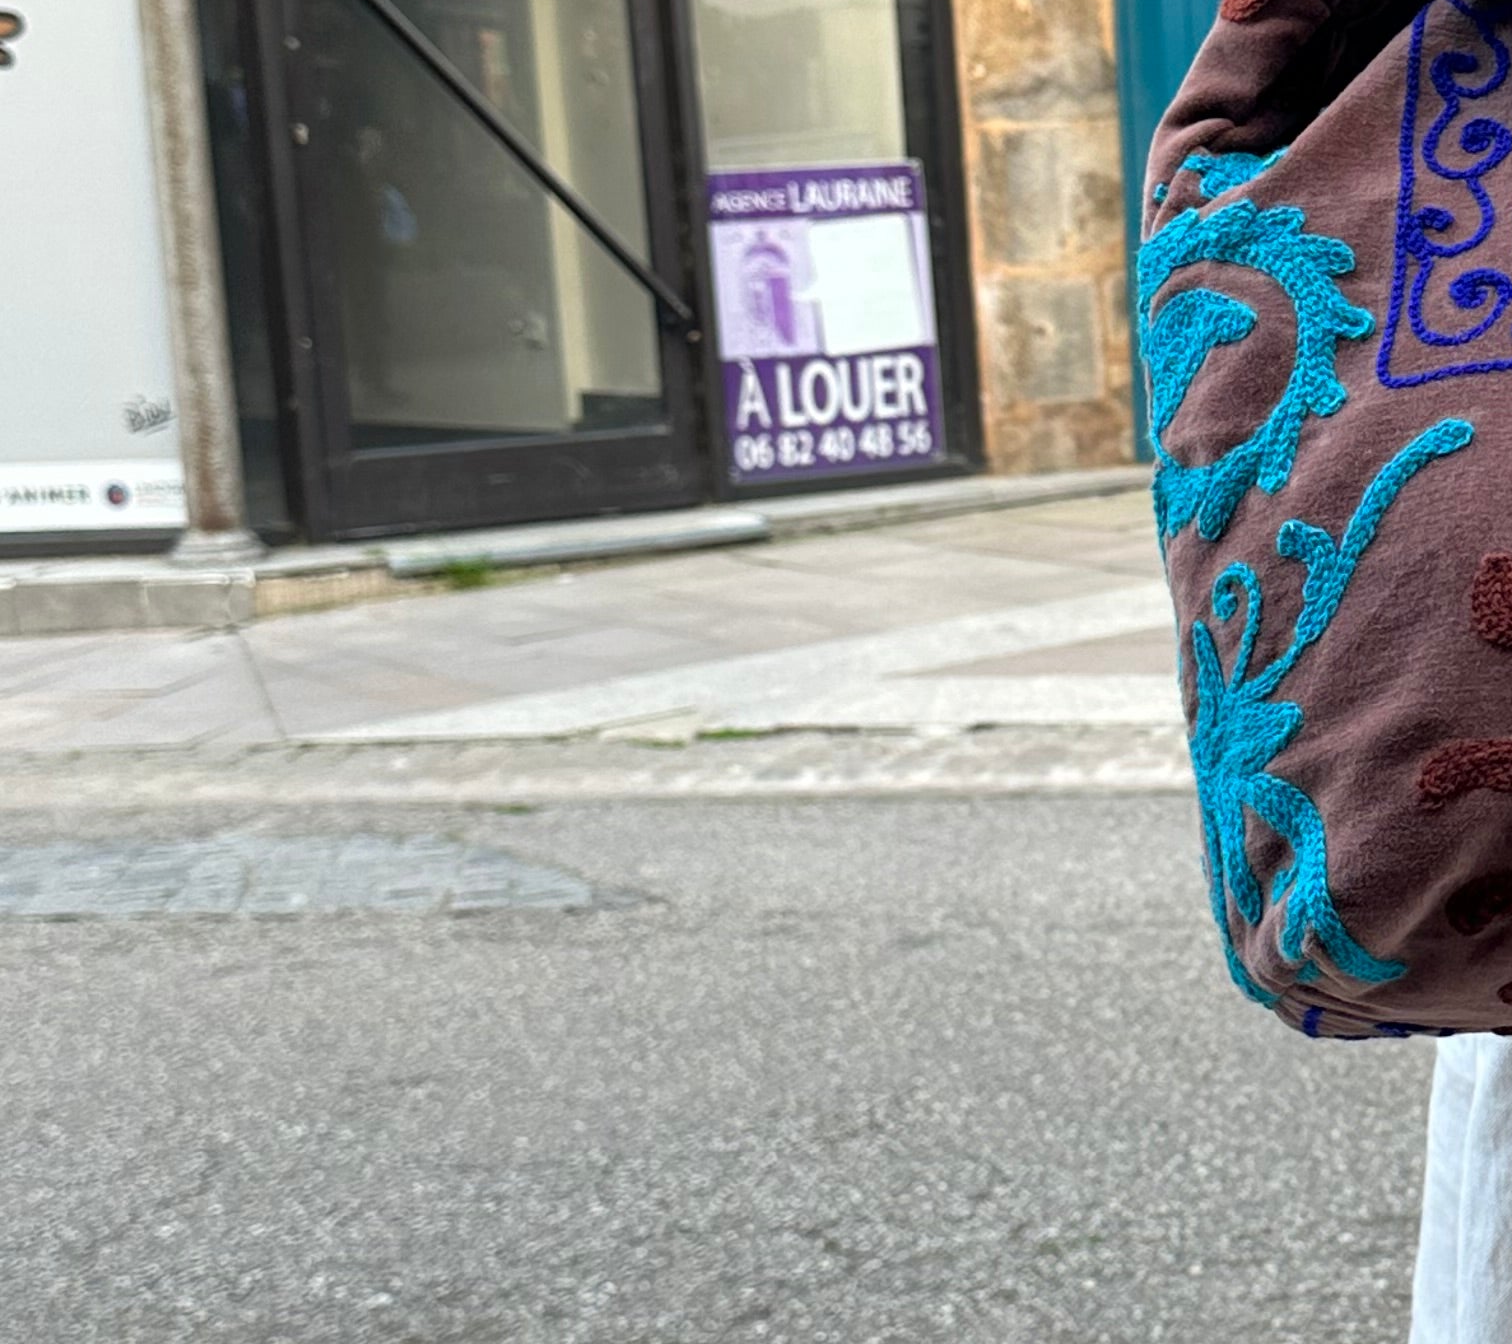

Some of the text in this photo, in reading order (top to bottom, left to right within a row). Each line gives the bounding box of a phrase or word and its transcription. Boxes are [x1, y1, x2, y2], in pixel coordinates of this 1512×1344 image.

[712, 190, 786, 213] AGENCE
[776, 354, 927, 427] LOUER
[734, 434, 775, 470] 06
